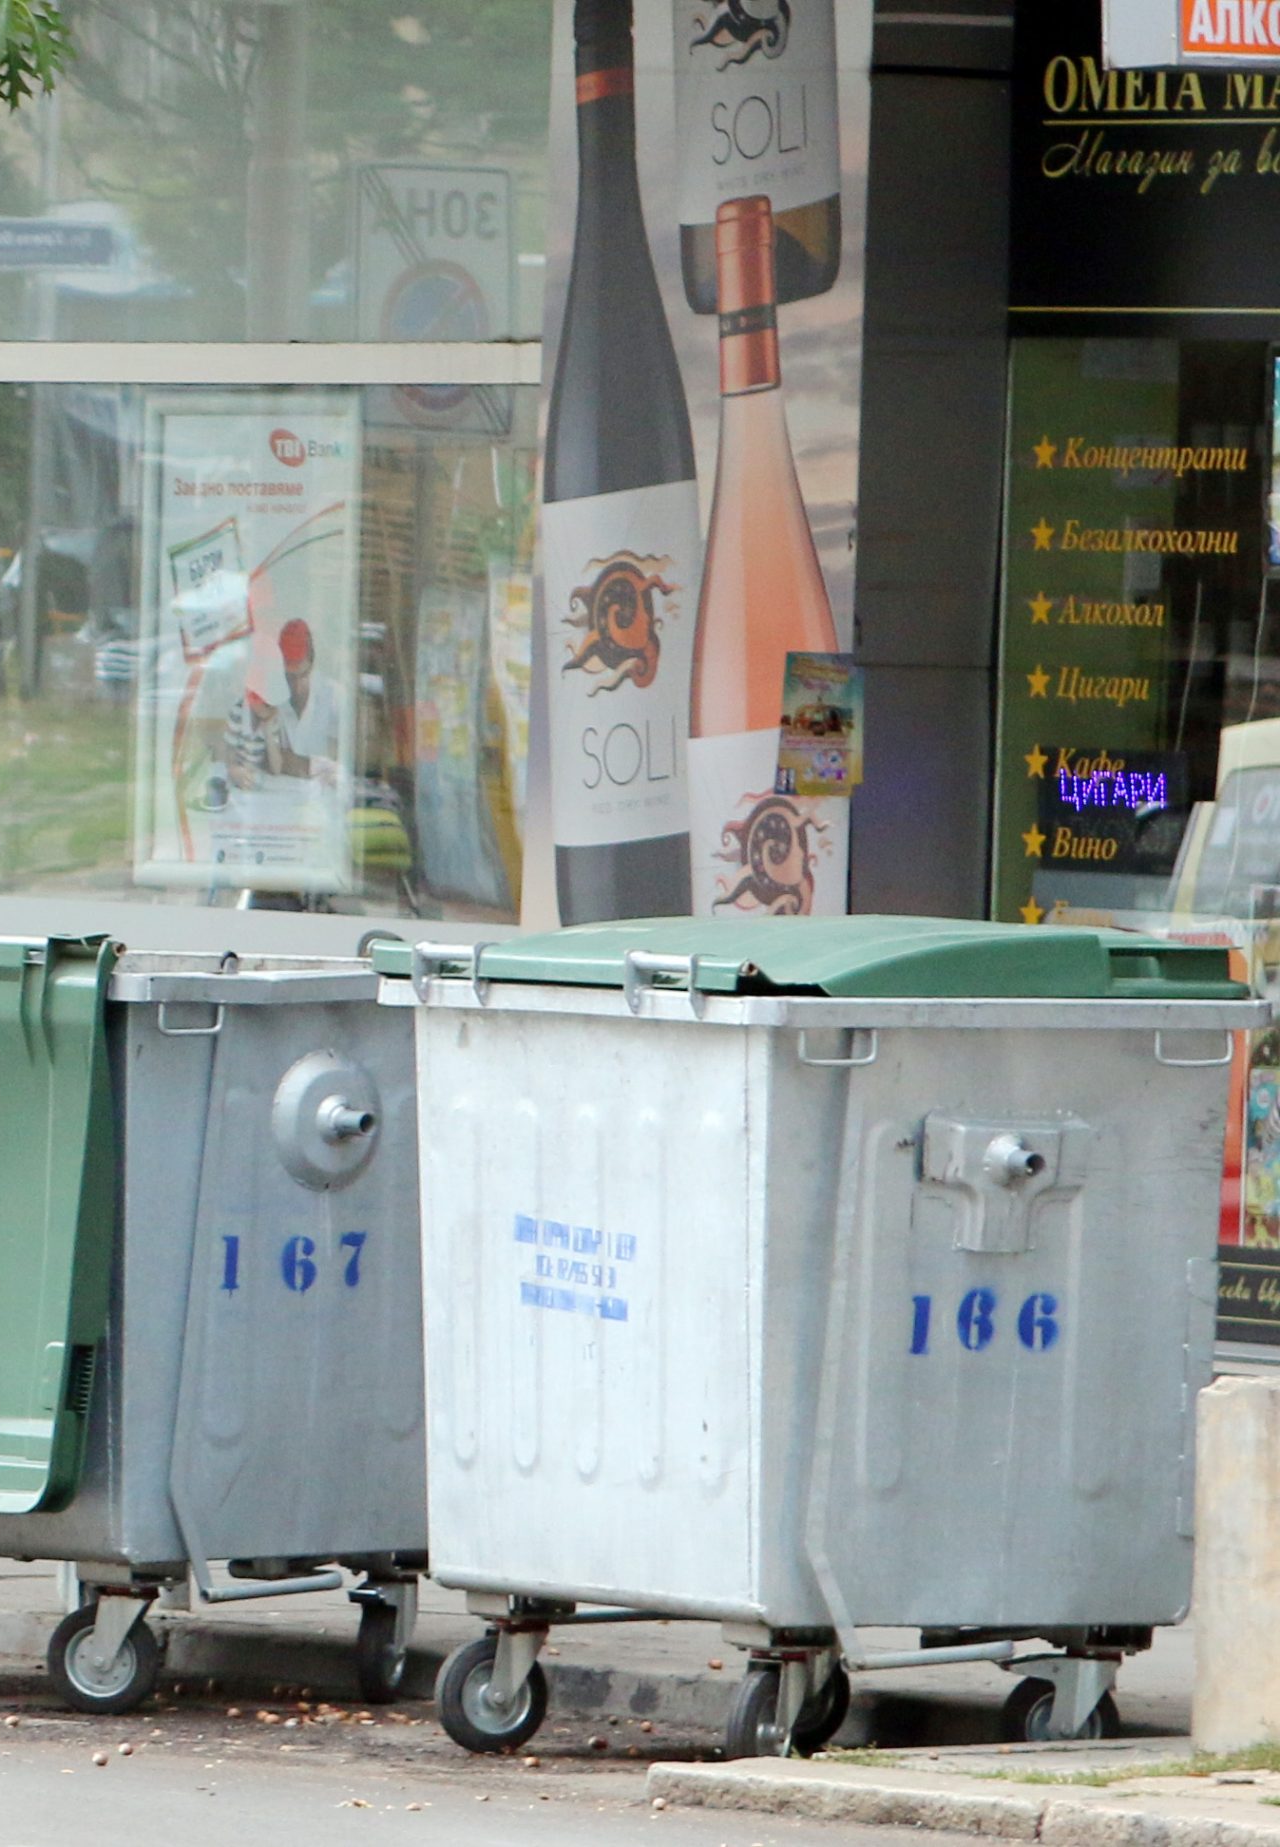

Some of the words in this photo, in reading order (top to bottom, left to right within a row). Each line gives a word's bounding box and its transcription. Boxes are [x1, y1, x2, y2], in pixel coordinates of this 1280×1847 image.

[711, 84, 808, 165] SOLI
[1042, 129, 1193, 195] Магазин
[1200, 150, 1241, 195] за
[1063, 437, 1248, 478] Концентрати
[1061, 519, 1239, 554] Безалкохолни
[1058, 595, 1165, 628] Алкохол
[1057, 666, 1150, 708] Цигари
[582, 715, 677, 789] SOLI
[1058, 767, 1168, 812] ЦИГАРИ
[1051, 826, 1118, 860] Вино
[220, 1231, 368, 1292] 167
[909, 1287, 1061, 1356] 166
